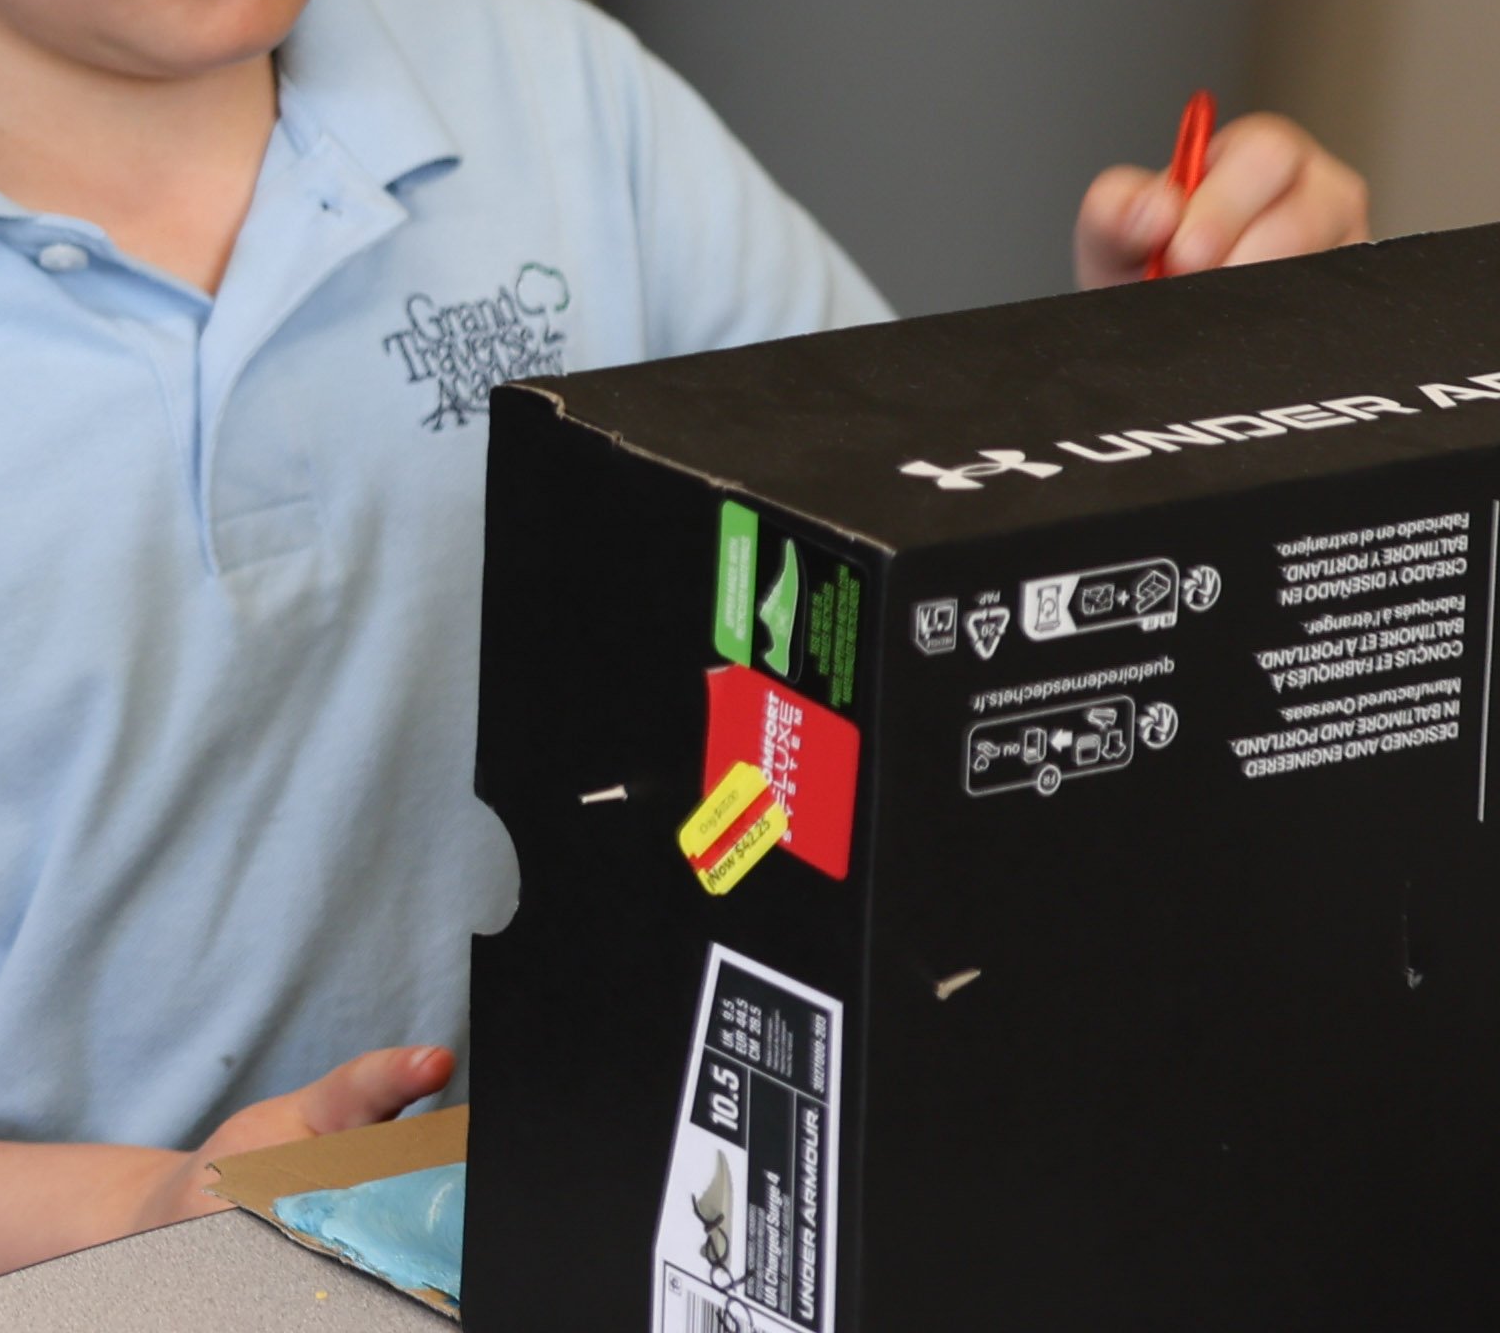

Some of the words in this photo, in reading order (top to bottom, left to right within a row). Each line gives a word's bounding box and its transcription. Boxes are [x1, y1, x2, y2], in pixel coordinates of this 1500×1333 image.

[406, 287, 521, 342] Grand
[1054, 395, 1422, 463] UNDER
[1356, 528, 1373, 547] el
[1375, 526, 1395, 540] en
[1399, 512, 1470, 538] Fabricado
[1276, 532, 1356, 557] extranjero.
[1383, 534, 1469, 565] BALTIMORE
[1282, 555, 1369, 583] PORTLAND.
[1370, 553, 1382, 567] Y
[1400, 557, 1468, 584] CREADO
[1305, 572, 1386, 600] DISEÑADO
[1388, 571, 1399, 587] Y
[979, 590, 1001, 605] PAP
[1281, 588, 1303, 606] EN
[1393, 595, 1466, 621] Fabriqués
[1381, 605, 1392, 622] à
[1358, 634, 1377, 652] ET
[1379, 617, 1465, 648] BALTIMORE
[1257, 639, 1343, 670] PORTLAND.
[1345, 637, 1357, 658] À
[1396, 640, 1463, 666] CONÇUS
[1289, 655, 1375, 690] FABRIQUÉS
[1375, 653, 1393, 671] ET
[1359, 677, 1462, 713] Manufactured
[1280, 696, 1356, 722] Overseas.
[1356, 702, 1442, 735] BALTIMORE
[1443, 700, 1460, 717] IN
[762, 690, 780, 783] OMFORT
[1230, 723, 1319, 757] PORTLAND.
[1321, 718, 1356, 737] AND
[1381, 721, 1459, 752] DESIGNED
[772, 700, 794, 806] ELUXE
[1244, 743, 1343, 779] ENGINEERED
[1345, 737, 1379, 759] AND
[709, 859, 736, 887] Now
[735, 817, 771, 859] $42.25
[723, 998, 735, 1022] 9.5
[722, 1030, 735, 1048] UK
[735, 1030, 747, 1055] EUR
[749, 1038, 760, 1062] CM
[710, 1065, 740, 1131] 10.5
[802, 1111, 819, 1227] ARMOUR
[767, 1189, 782, 1229] Surge
[765, 1231, 782, 1285] Charged
[800, 1226, 816, 1321] UNDER
[764, 1285, 778, 1308] UA
